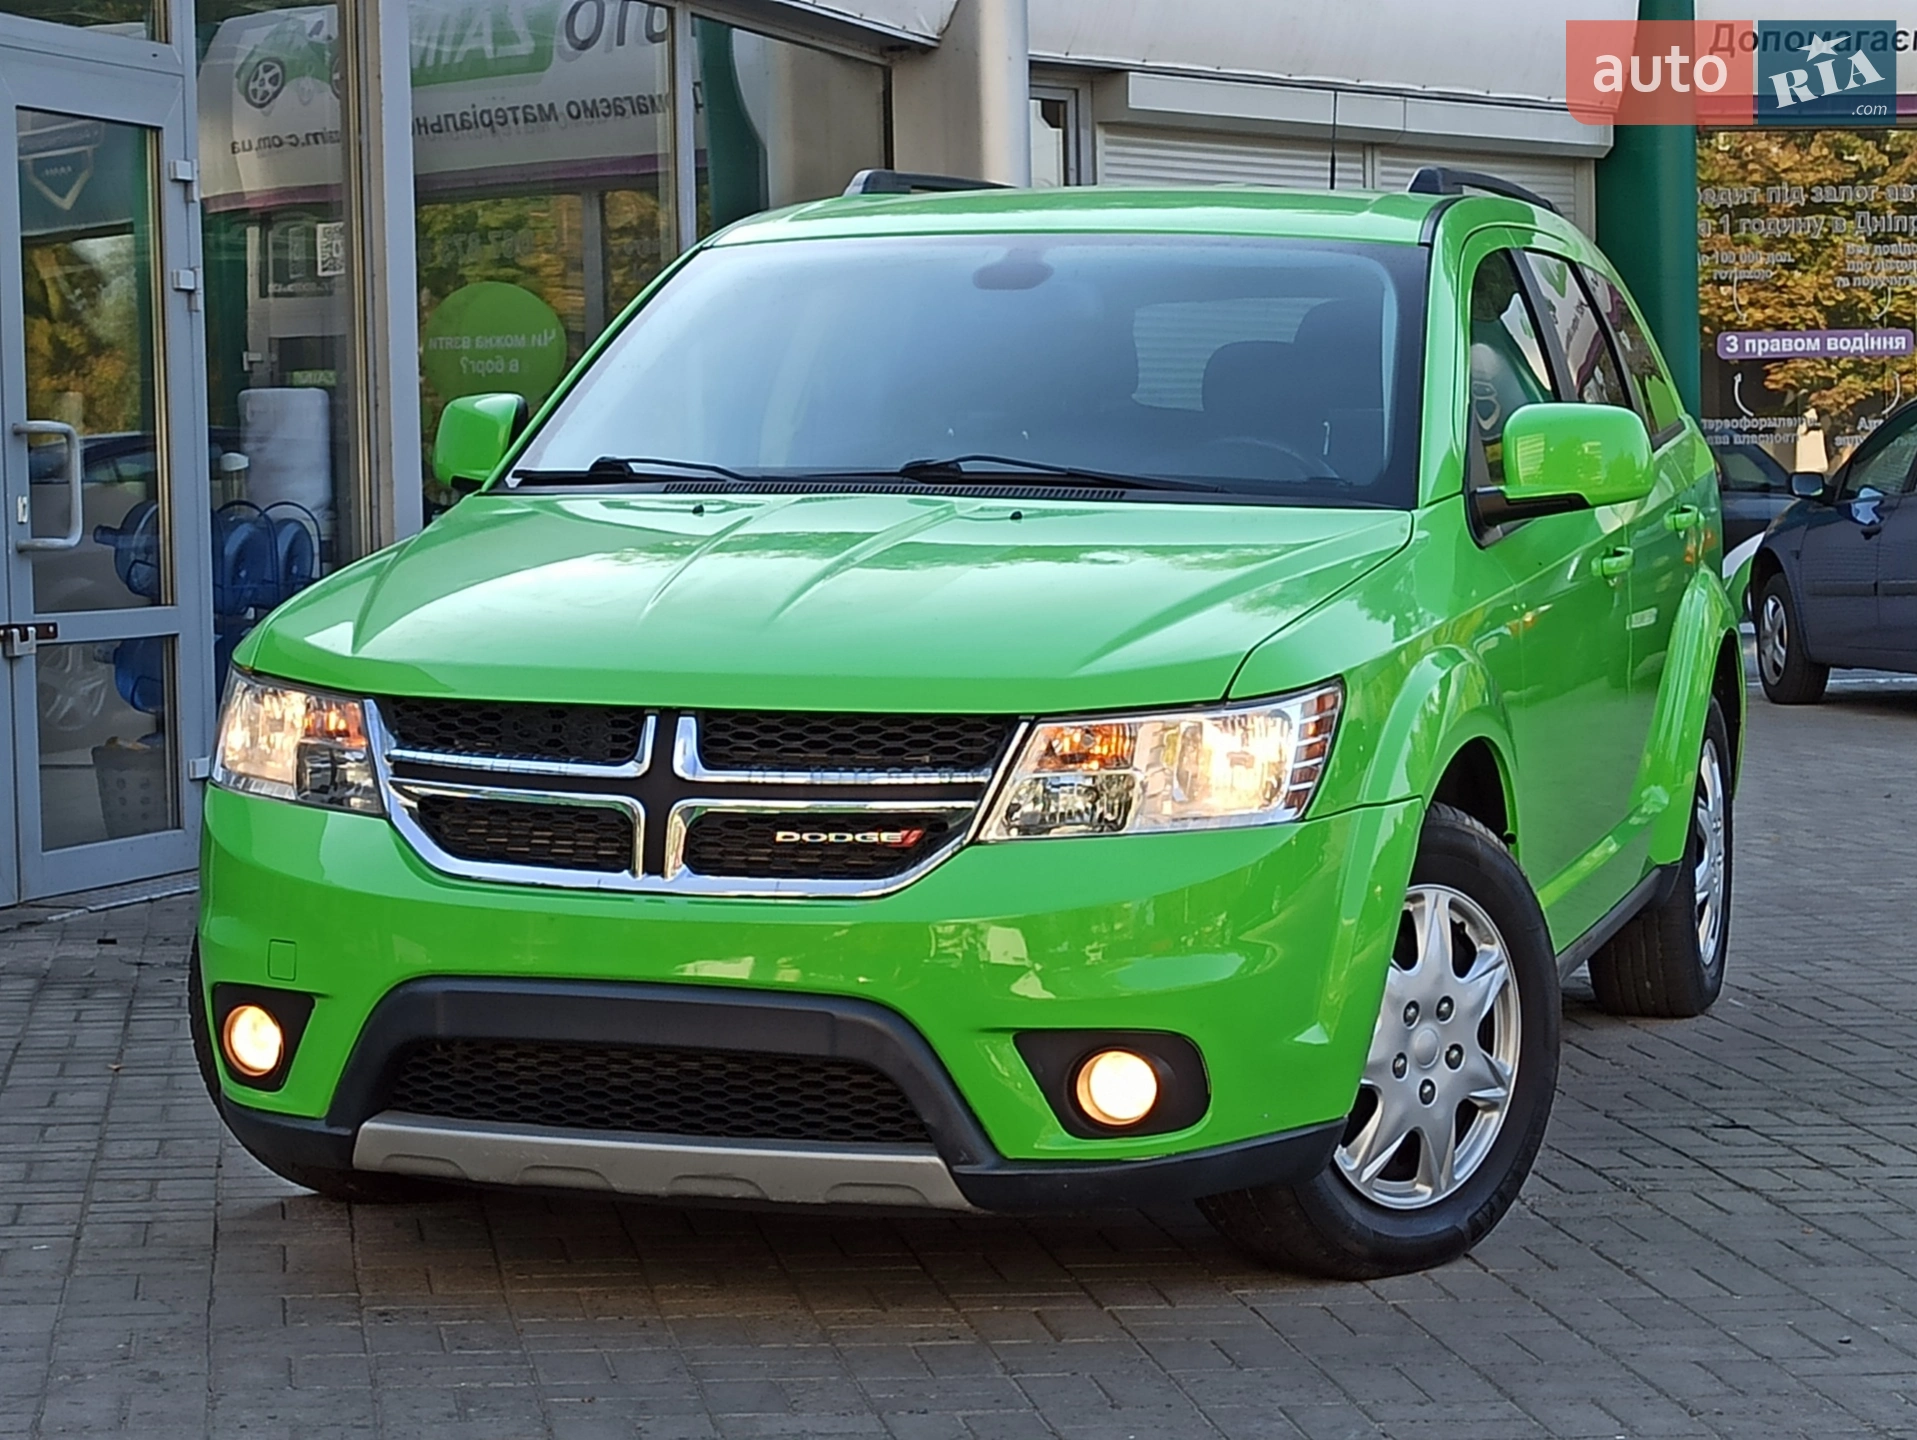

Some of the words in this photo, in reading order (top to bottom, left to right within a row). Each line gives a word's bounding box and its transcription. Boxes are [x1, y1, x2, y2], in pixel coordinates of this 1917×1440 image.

[1766, 182, 1805, 206] під
[1810, 184, 1879, 203] залог
[1719, 213, 1730, 236] 1
[1739, 216, 1826, 239] годину
[1832, 216, 1846, 234] в
[1744, 335, 1821, 356] правом
[1826, 331, 1906, 353] водіння
[775, 831, 903, 843] DODGE
